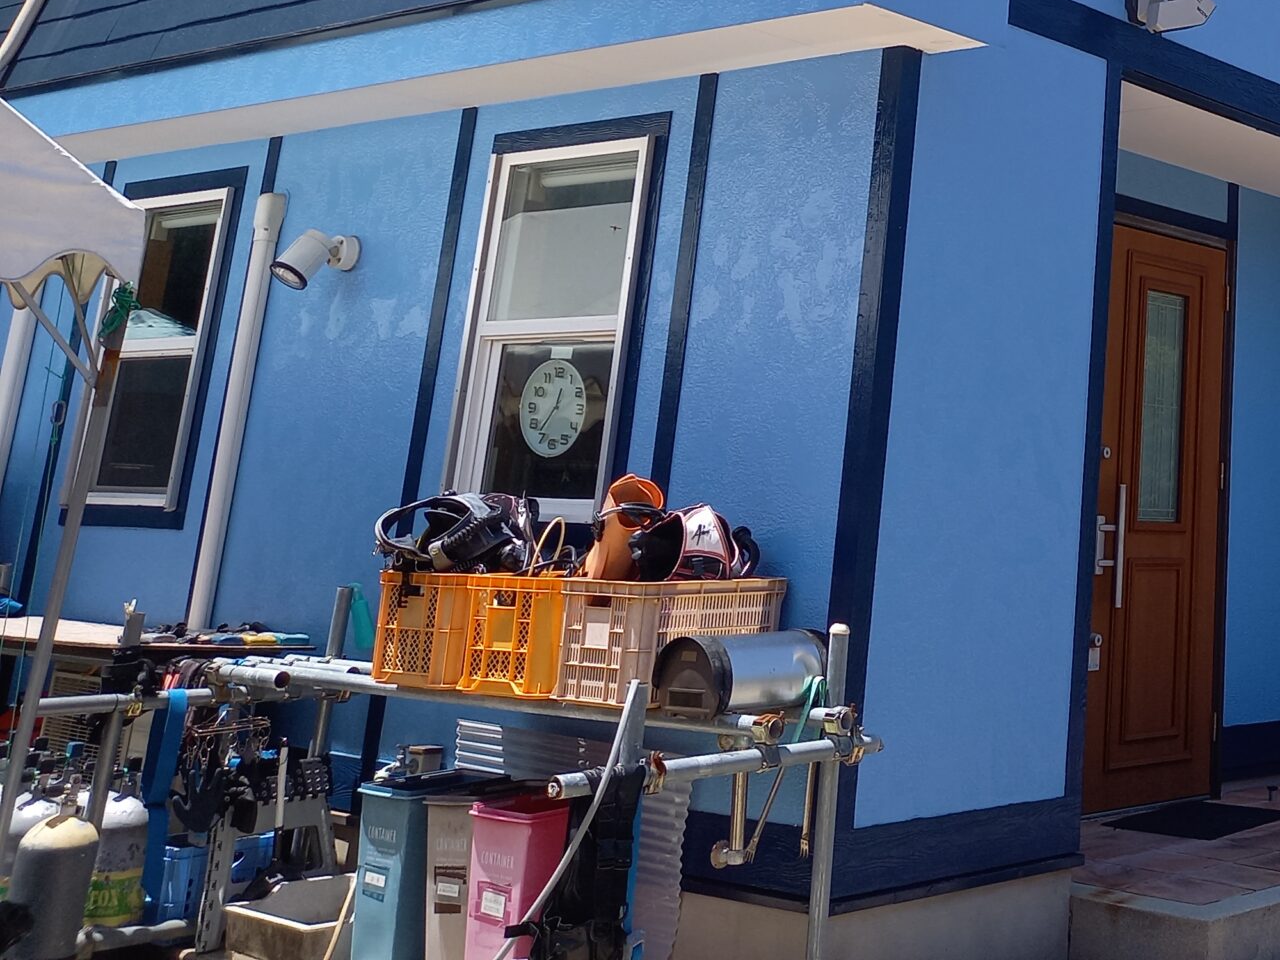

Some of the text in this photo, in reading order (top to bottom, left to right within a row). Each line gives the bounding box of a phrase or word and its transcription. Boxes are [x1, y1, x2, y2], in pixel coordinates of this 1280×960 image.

[544, 372, 552, 384] 11
[554, 366, 565, 378] 12
[534, 386, 545, 397] 10
[575, 387, 583, 398] 2
[528, 402, 537, 414] 9
[576, 403, 584, 415] 3
[529, 418, 538, 430] 8
[570, 421, 578, 433] 4
[538, 432, 546, 444] 7
[547, 438, 557, 450] 6
[560, 434, 570, 445] 5
[368, 825, 397, 843] CONTAINER
[481, 849, 514, 869] CONTAINER
